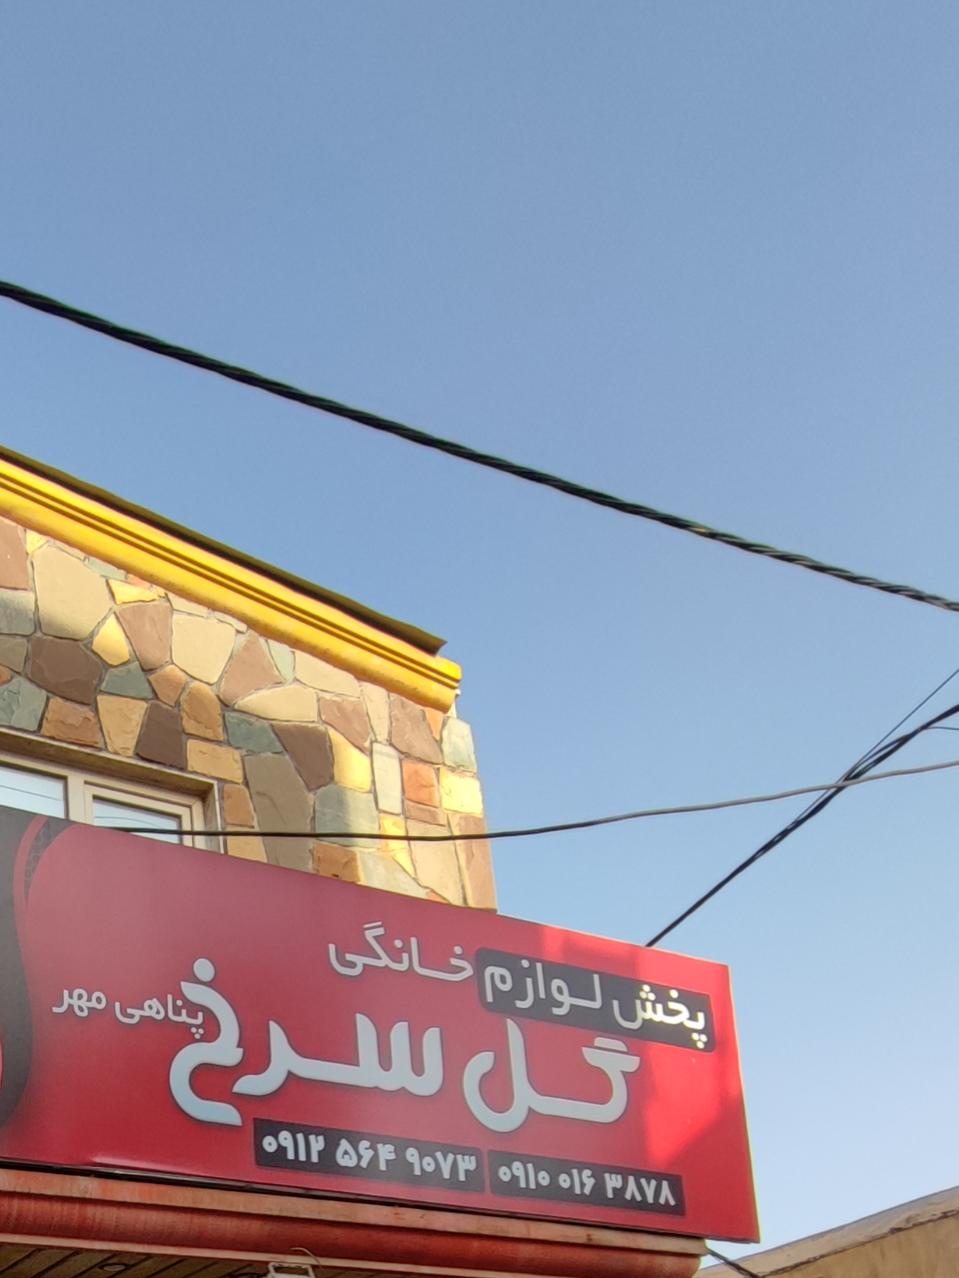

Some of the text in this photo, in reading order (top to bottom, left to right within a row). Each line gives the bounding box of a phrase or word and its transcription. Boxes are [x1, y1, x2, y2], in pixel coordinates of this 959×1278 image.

[328, 921, 708, 1049] پخش لوازم خانگی
[52, 988, 205, 1040] پناهی مهر
[169, 957, 640, 1133] گل سرخ
[262, 1130, 478, 1182] ۰۹۱۲ ۵۶۴ ۹۰۷۳
[498, 1162, 677, 1207] ۰۹۱۰ ۰۱۶ ۳۸۷۸
